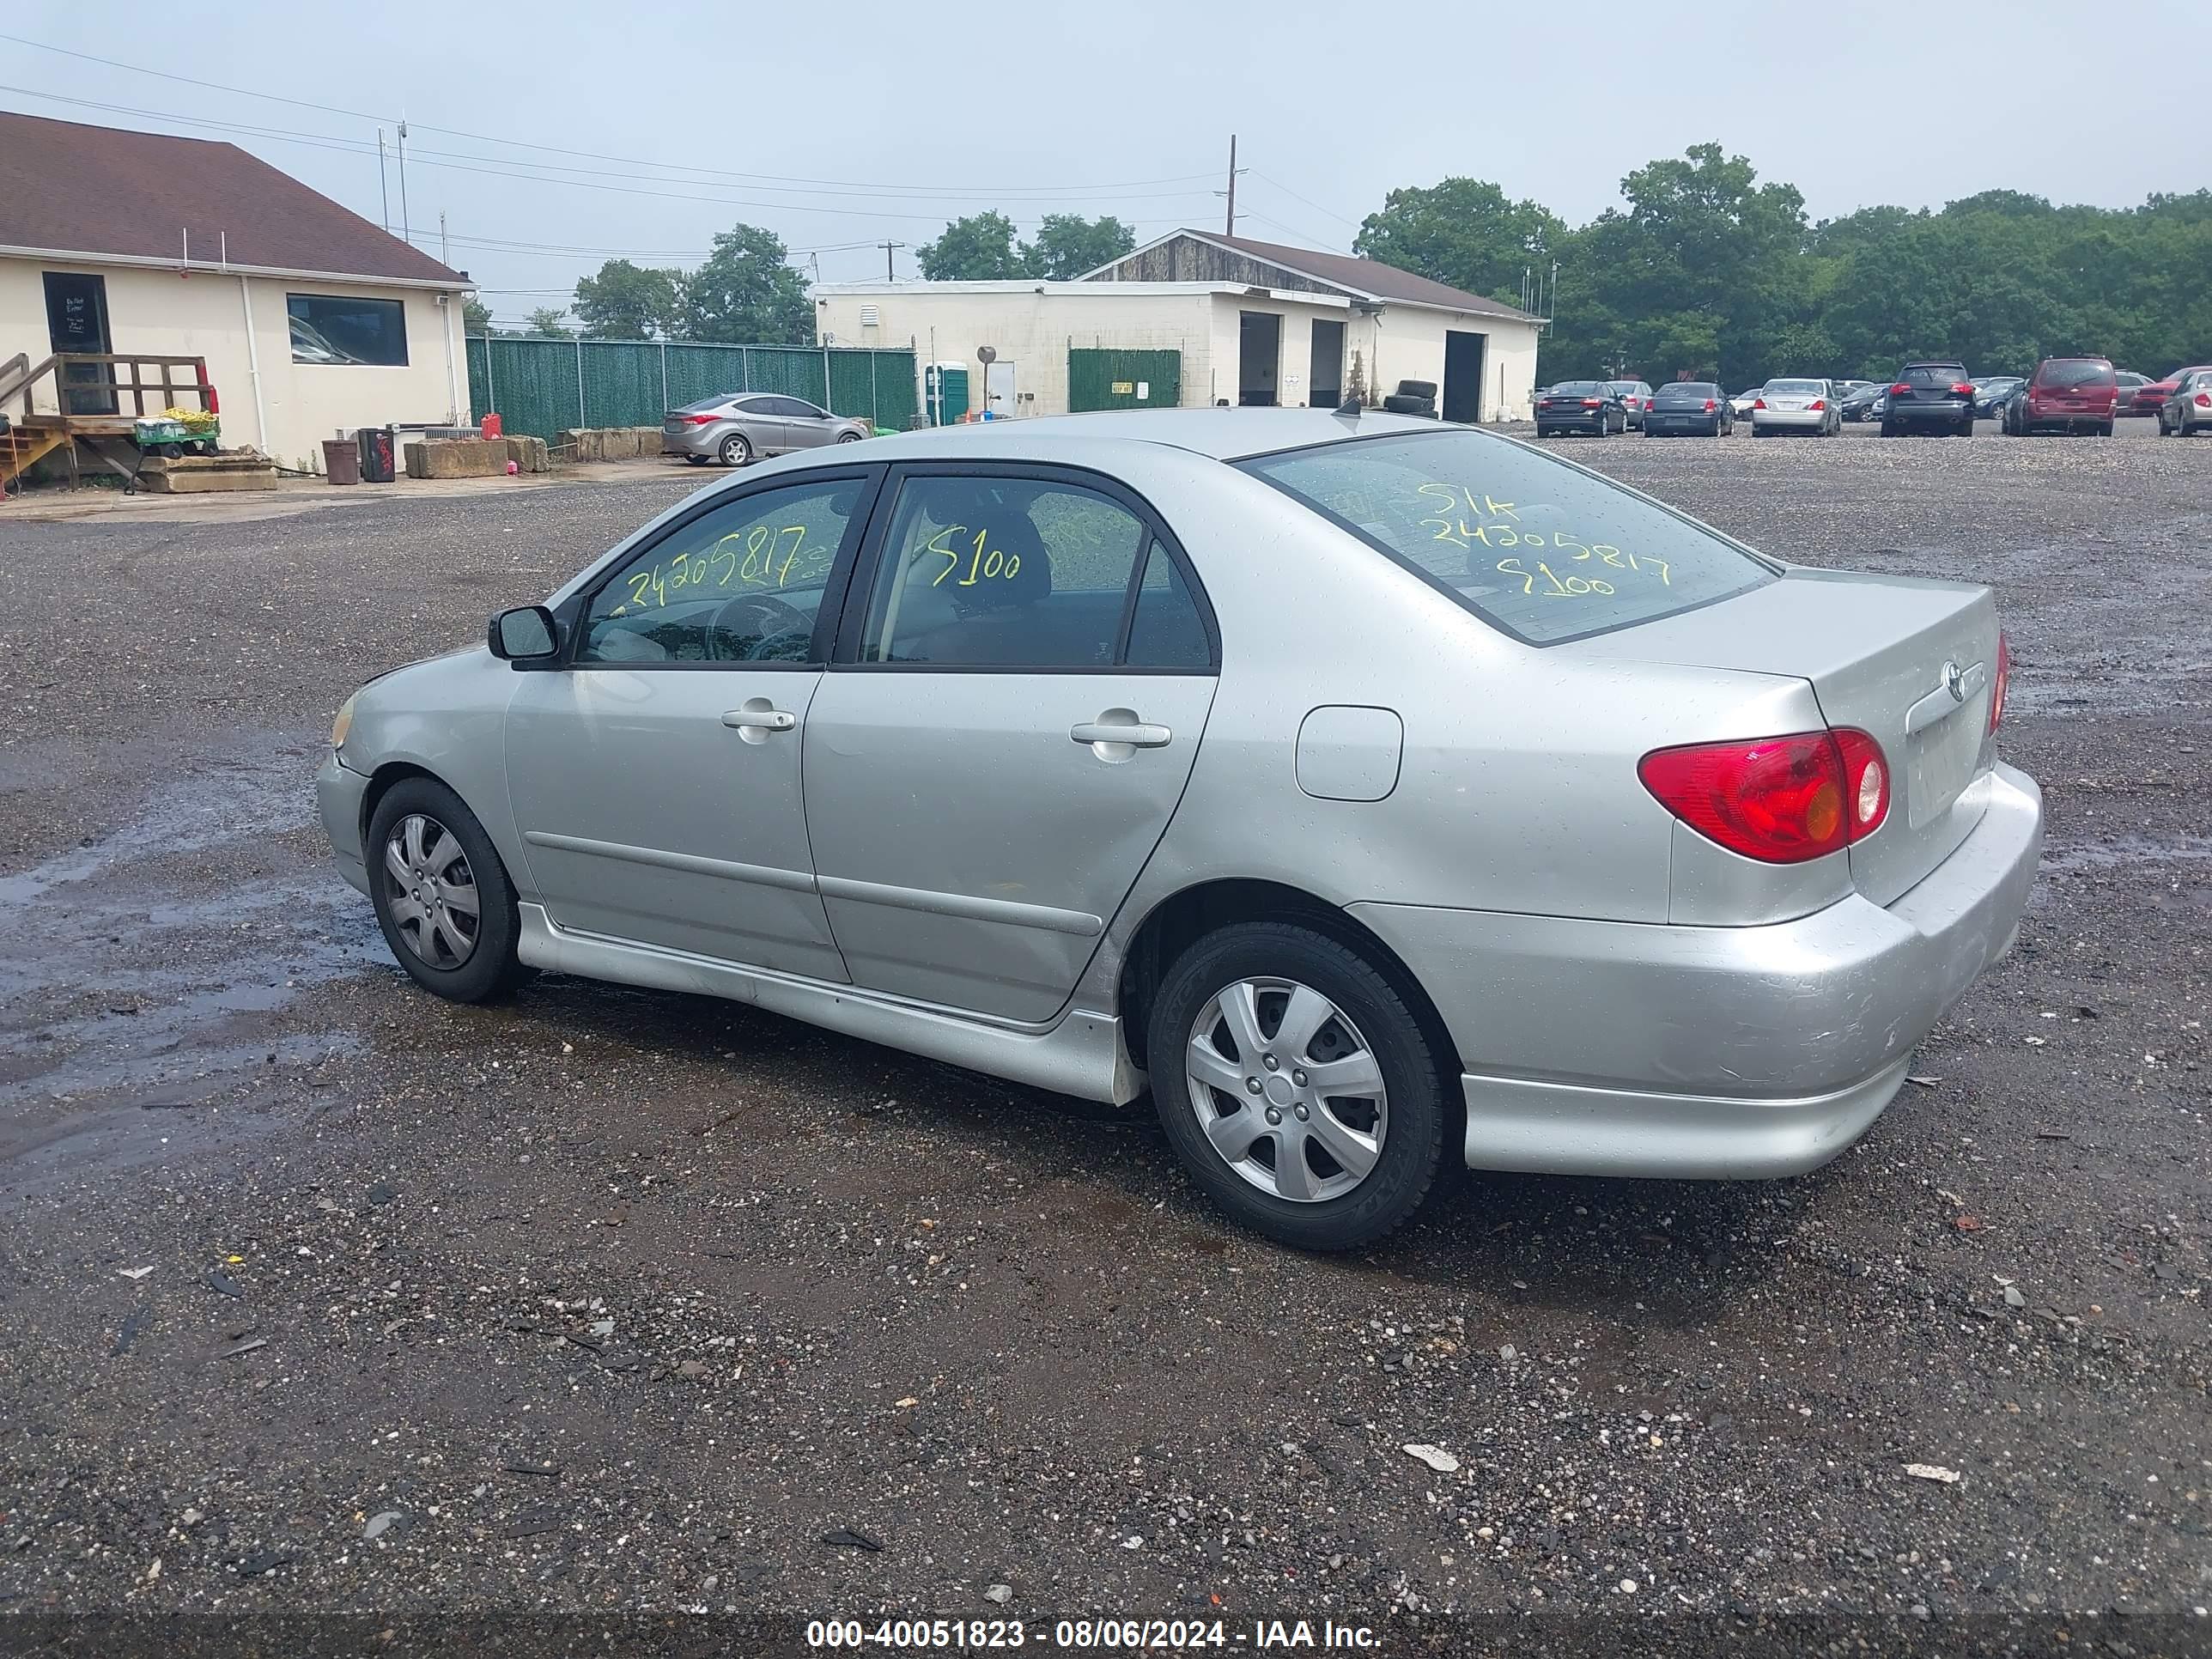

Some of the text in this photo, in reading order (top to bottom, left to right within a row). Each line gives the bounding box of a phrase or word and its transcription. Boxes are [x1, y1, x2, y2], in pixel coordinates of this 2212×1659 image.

[627, 526, 806, 607] 24205817
[927, 526, 1020, 586] S100
[1419, 519, 1670, 586] 24205817
[1497, 558, 1615, 597] S100
